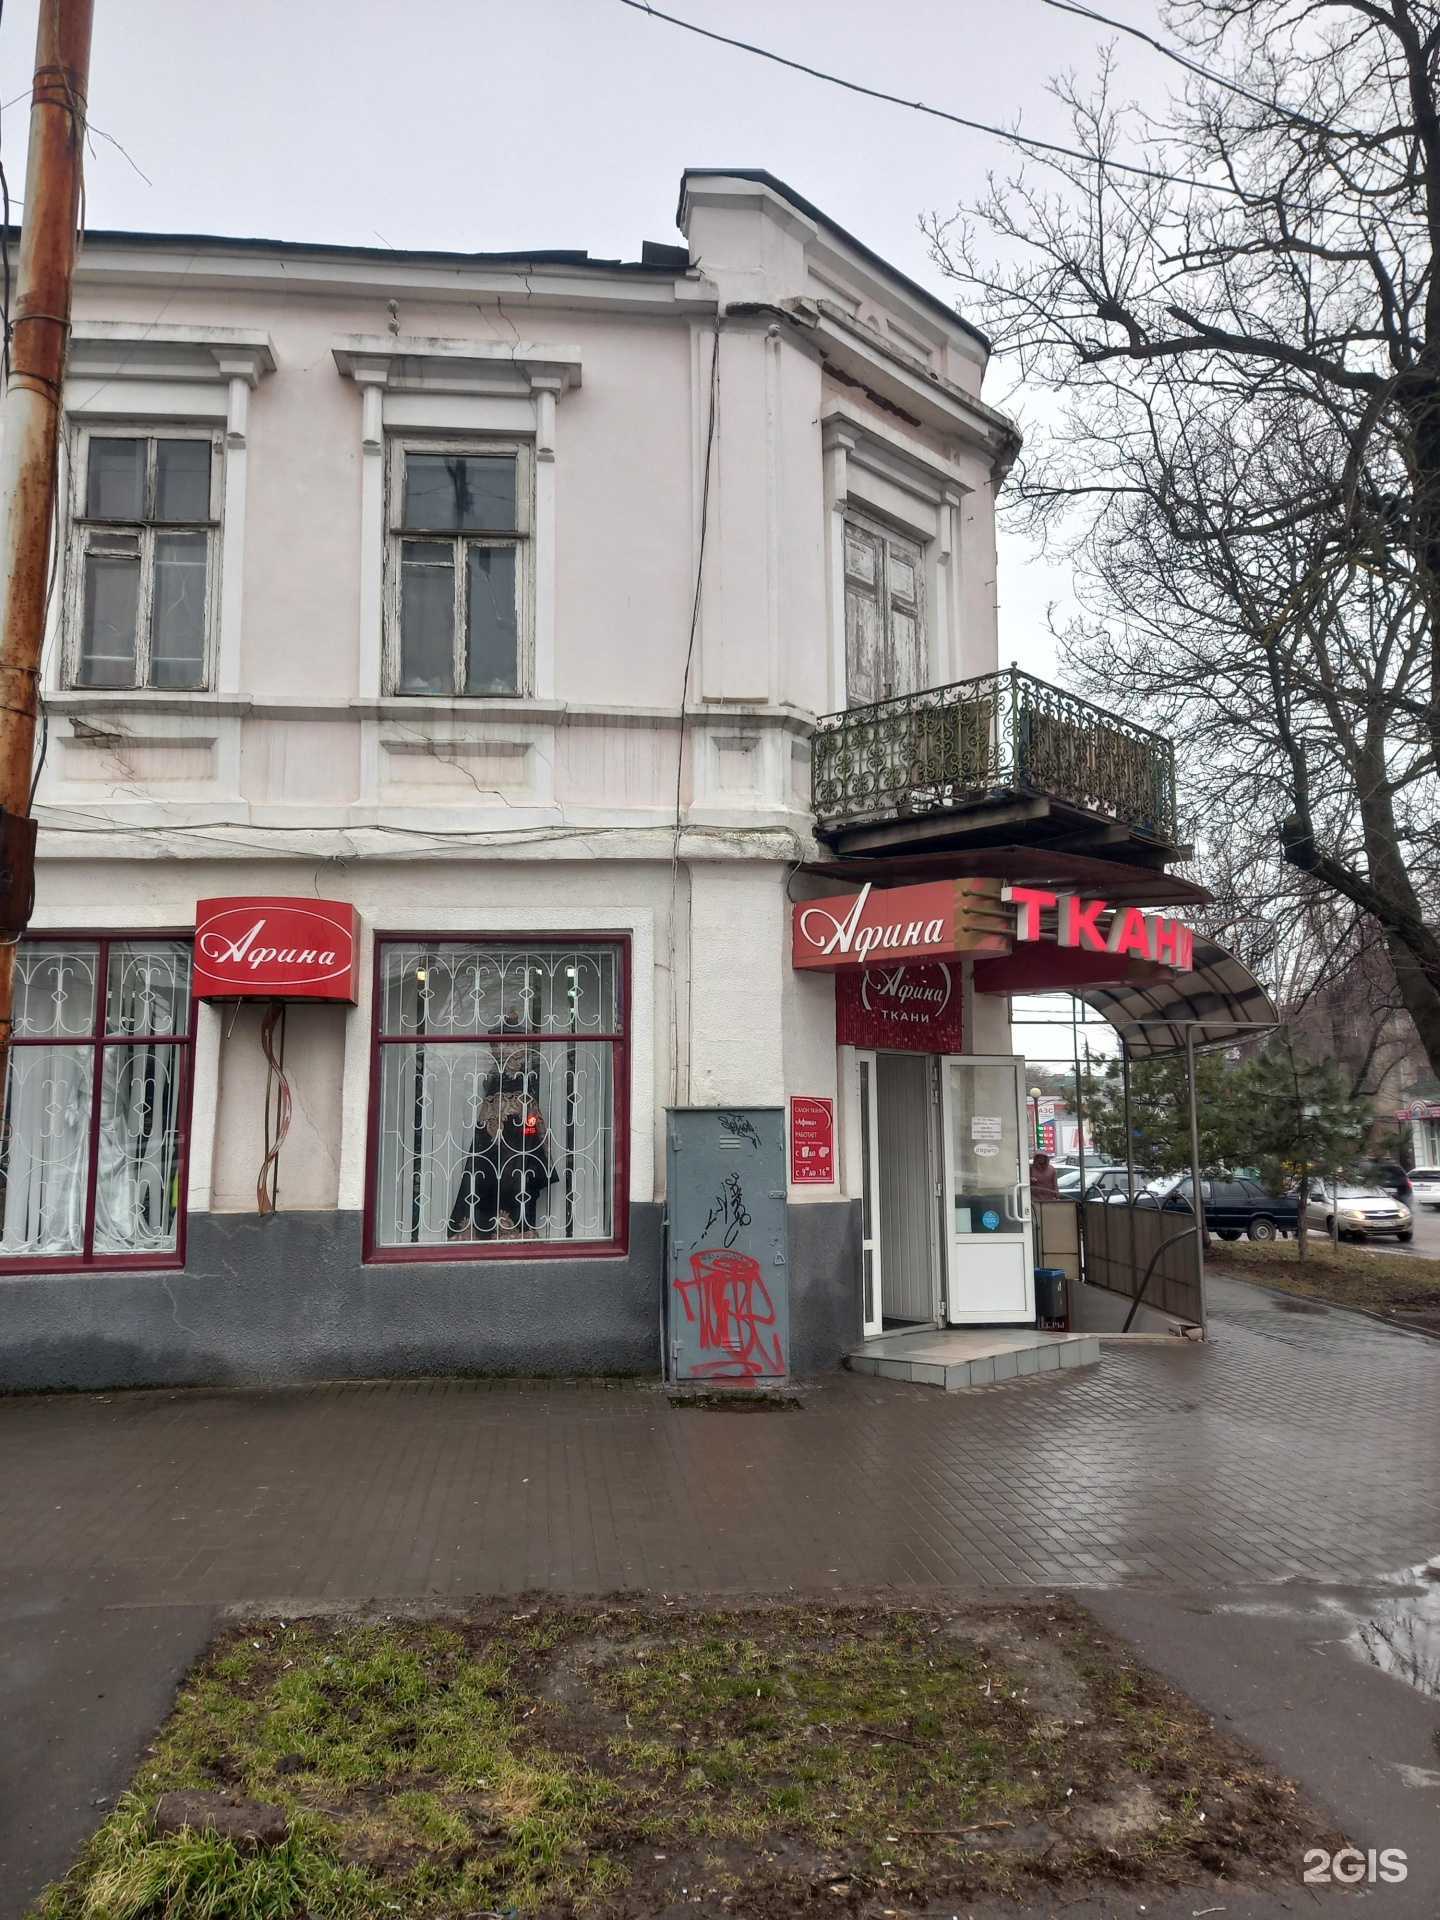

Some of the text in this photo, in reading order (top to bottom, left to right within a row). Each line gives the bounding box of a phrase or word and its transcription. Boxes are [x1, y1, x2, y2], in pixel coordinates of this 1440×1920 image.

[800, 882, 944, 962] Афина
[200, 919, 336, 970] Афина
[865, 966, 943, 1004] Афина
[881, 1009, 930, 1023] ТКАНИ
